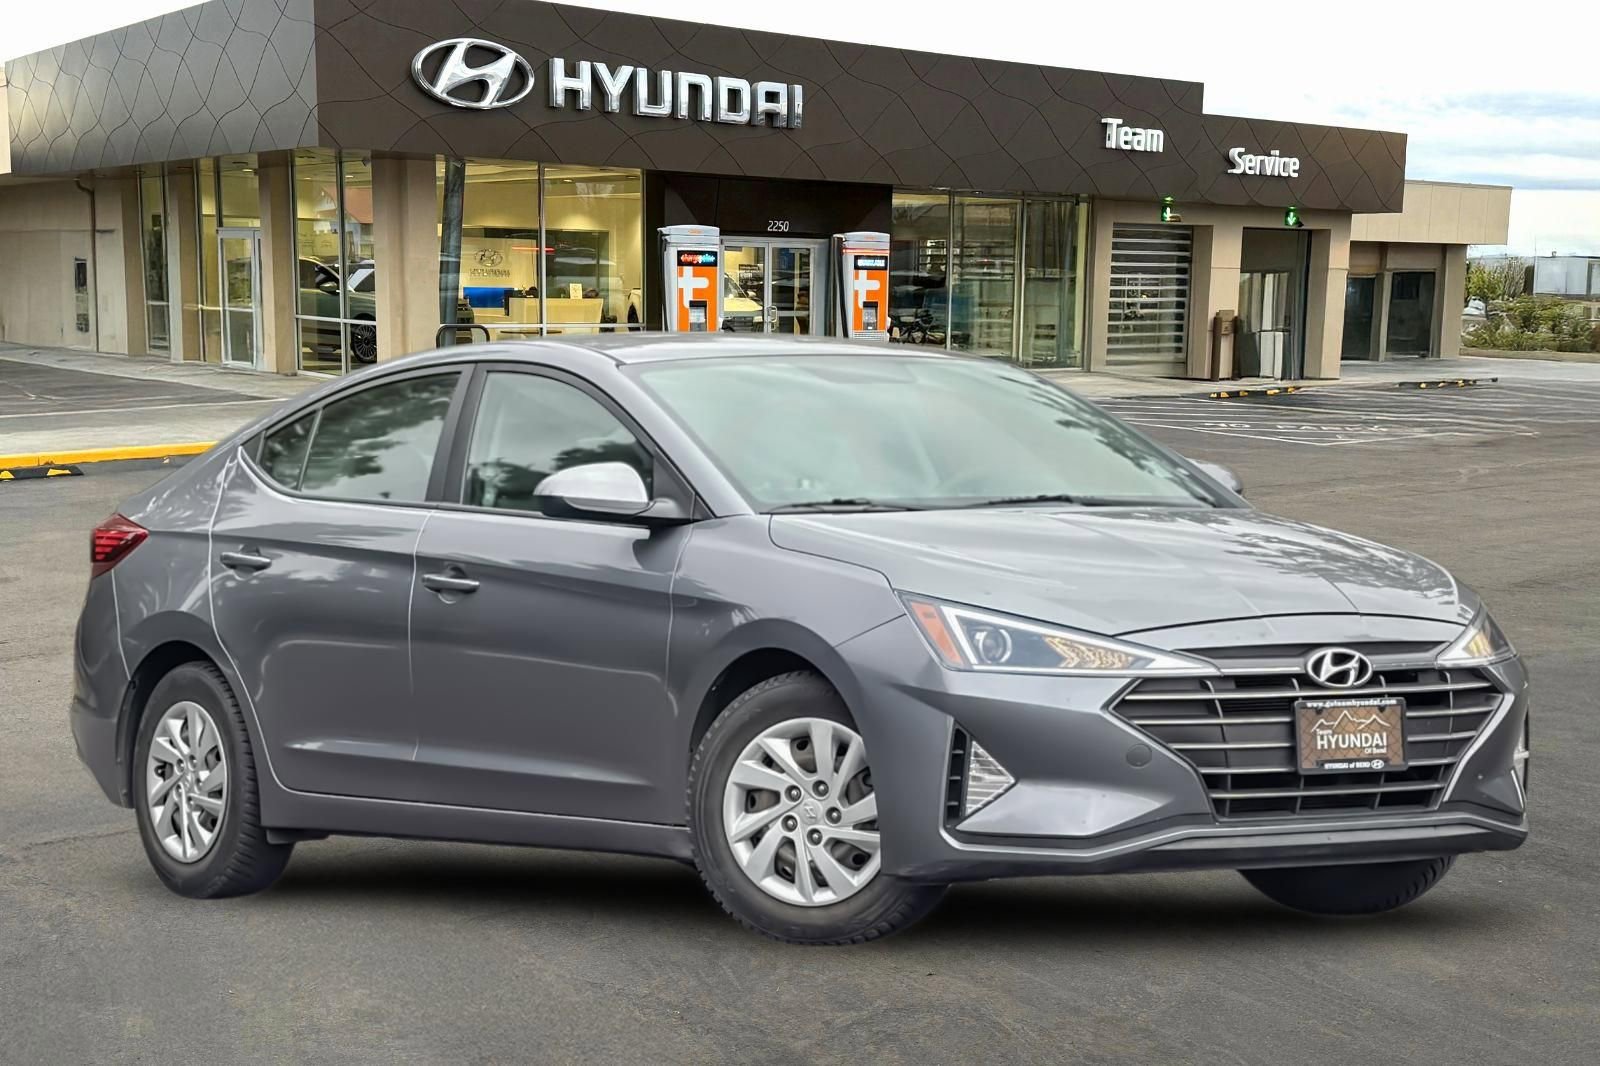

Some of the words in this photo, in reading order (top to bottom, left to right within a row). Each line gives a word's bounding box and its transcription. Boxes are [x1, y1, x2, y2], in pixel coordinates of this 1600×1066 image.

[548, 57, 803, 129] HYUNDAI
[1101, 117, 1164, 153] Team
[1227, 147, 1300, 178] Service
[767, 220, 790, 232] 2250
[1316, 732, 1387, 750] HYUNDAI
